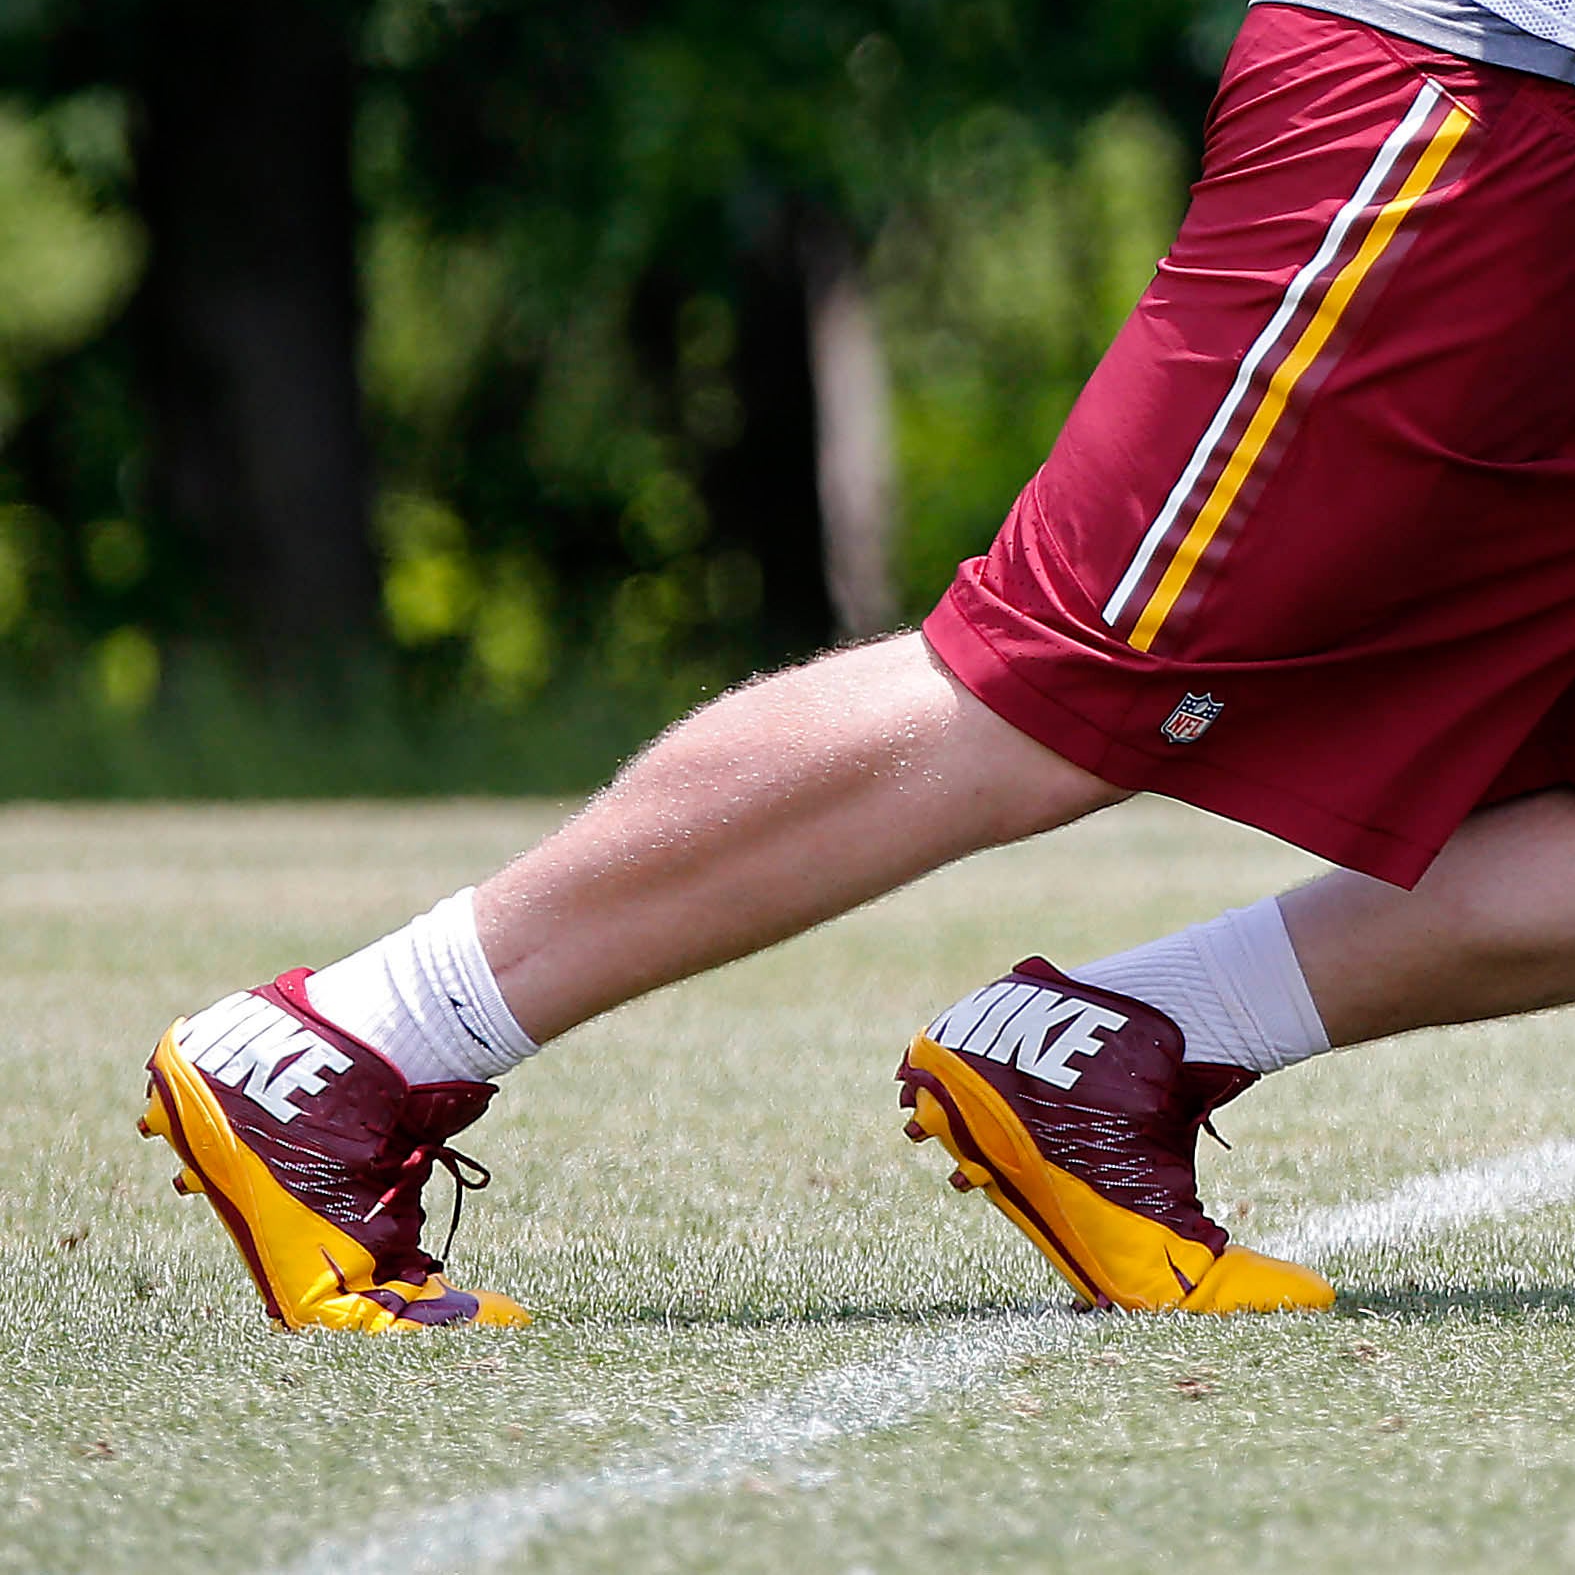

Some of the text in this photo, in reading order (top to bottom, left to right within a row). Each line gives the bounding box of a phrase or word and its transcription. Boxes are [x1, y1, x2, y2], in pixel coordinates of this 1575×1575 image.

[1168, 713, 1204, 737] NFL
[173, 990, 355, 1124] NIKE
[926, 981, 1130, 1091] NIKE
